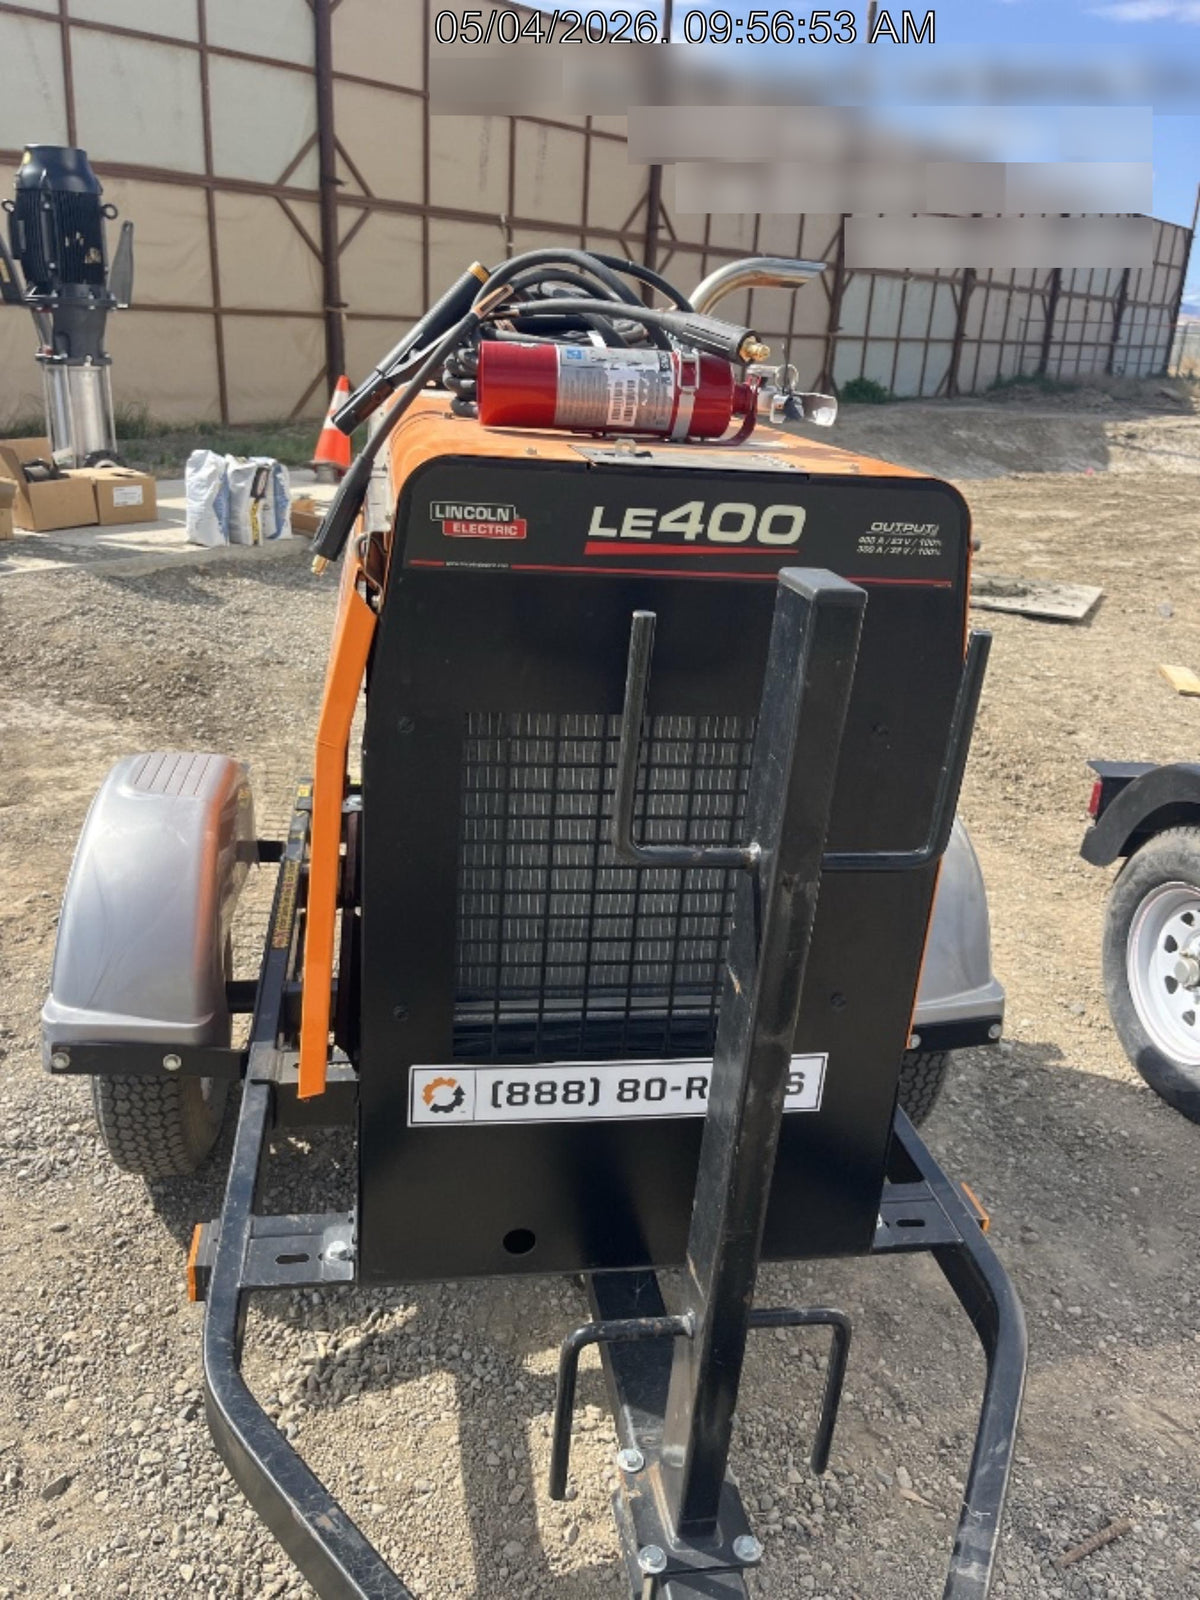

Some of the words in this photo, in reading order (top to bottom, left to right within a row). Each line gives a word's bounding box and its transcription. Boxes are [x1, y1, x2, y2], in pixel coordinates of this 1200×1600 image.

[435, 504, 510, 521] LINCOLN
[453, 522, 518, 536] ELECTRIC
[588, 501, 806, 545] LE400
[870, 522, 936, 533] OUTPUT
[491, 1076, 600, 1108] (888)
[617, 1071, 806, 1104] 80-RS
